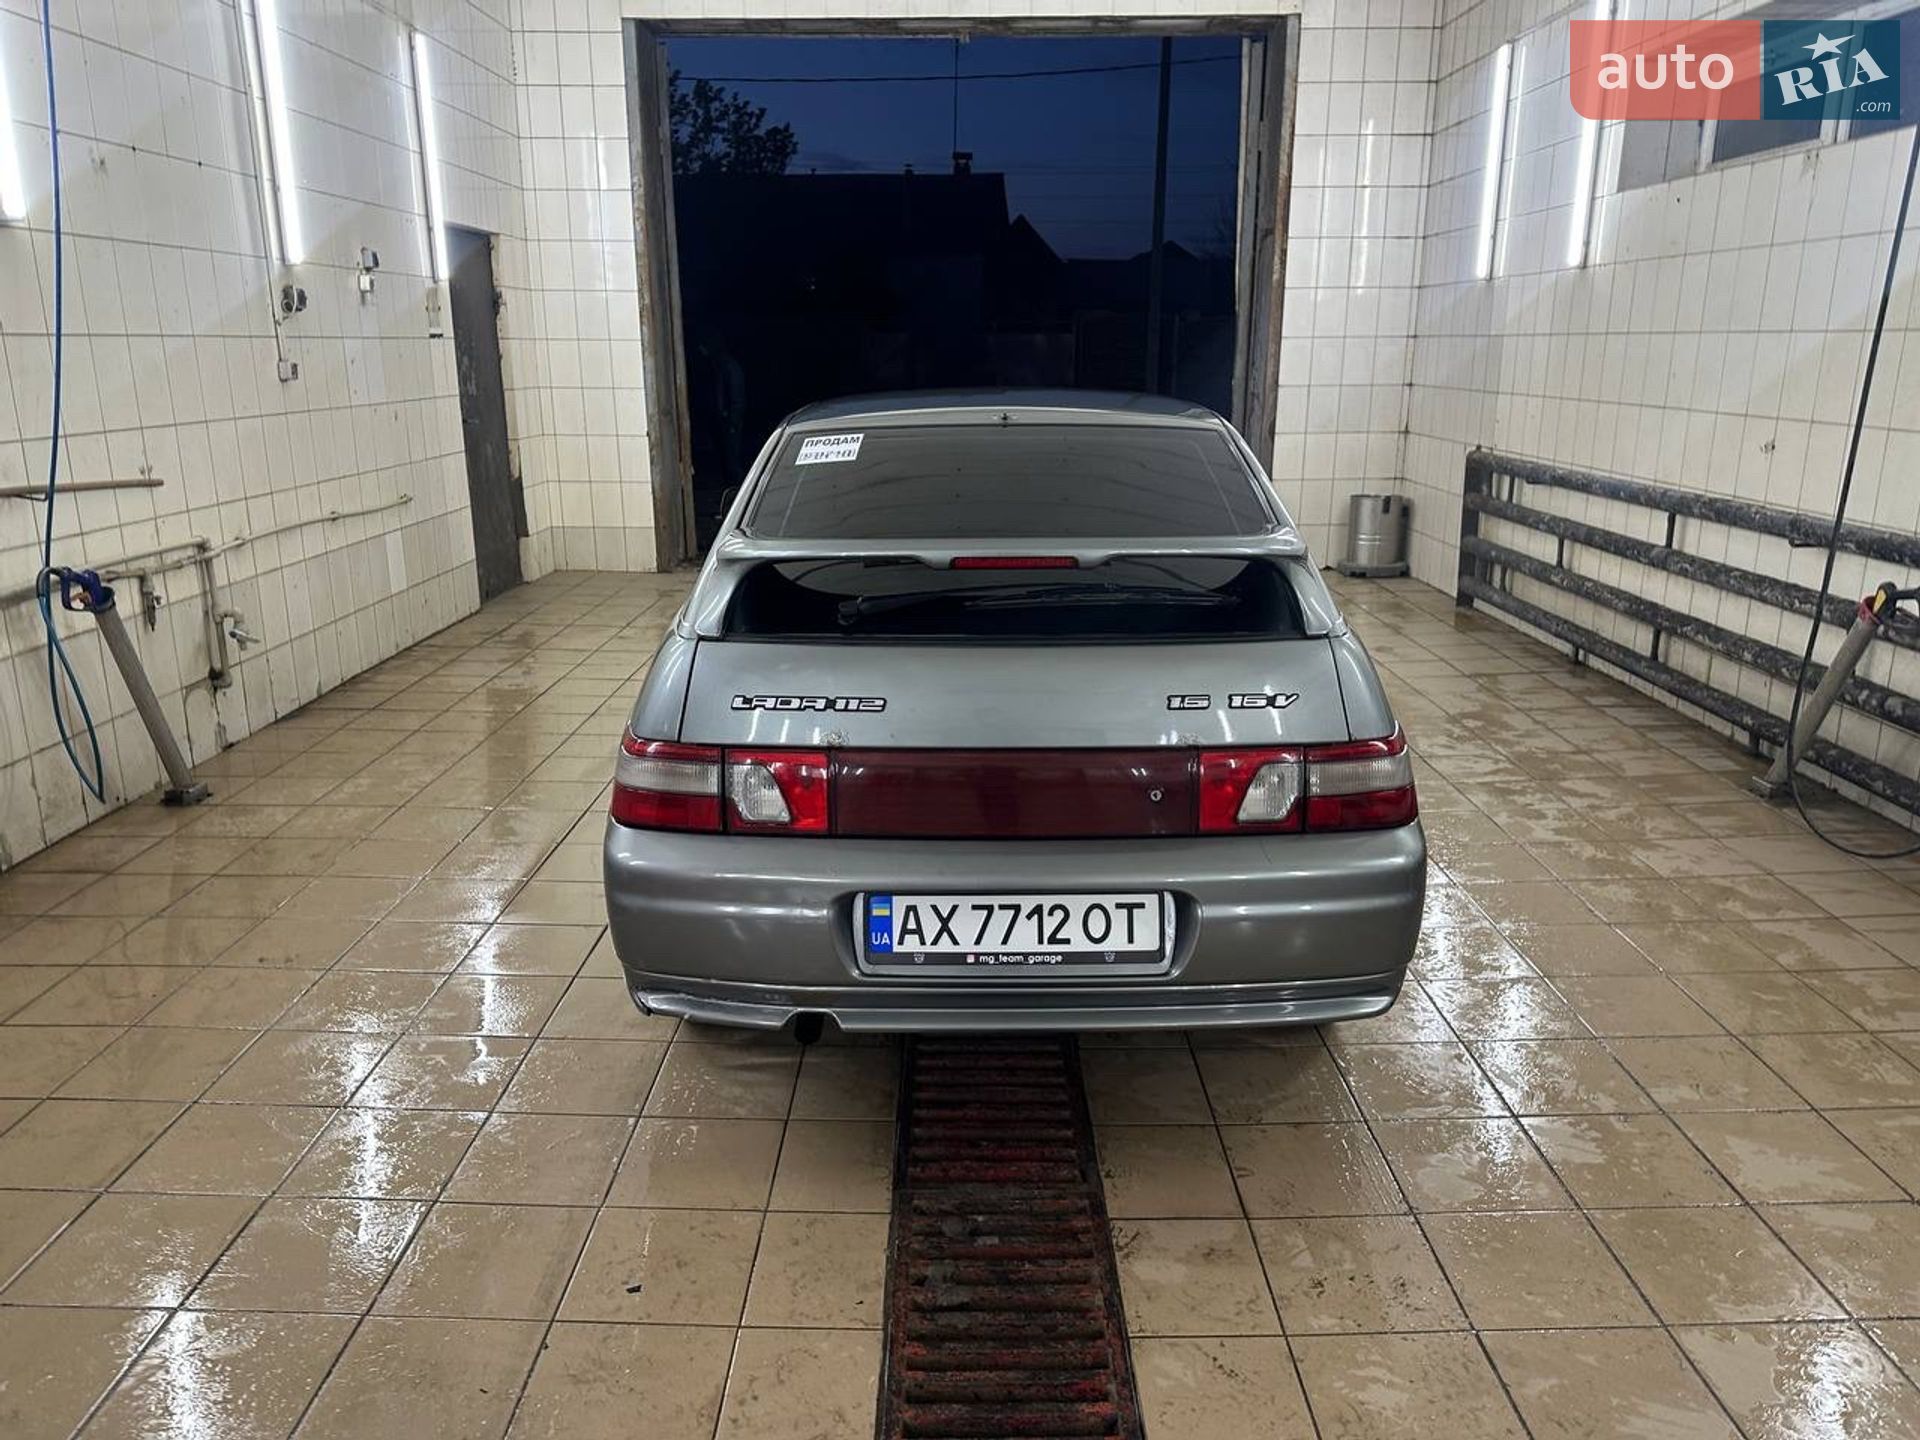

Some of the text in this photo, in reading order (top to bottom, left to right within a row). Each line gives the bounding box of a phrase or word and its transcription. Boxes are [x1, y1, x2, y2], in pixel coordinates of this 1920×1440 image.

[805, 436, 861, 448] ПРОДАМ
[731, 696, 886, 712] LADA 112
[897, 902, 1146, 946] AX 7712 OT
[872, 931, 890, 946] UA
[979, 954, 1063, 965] mg_team_garage
